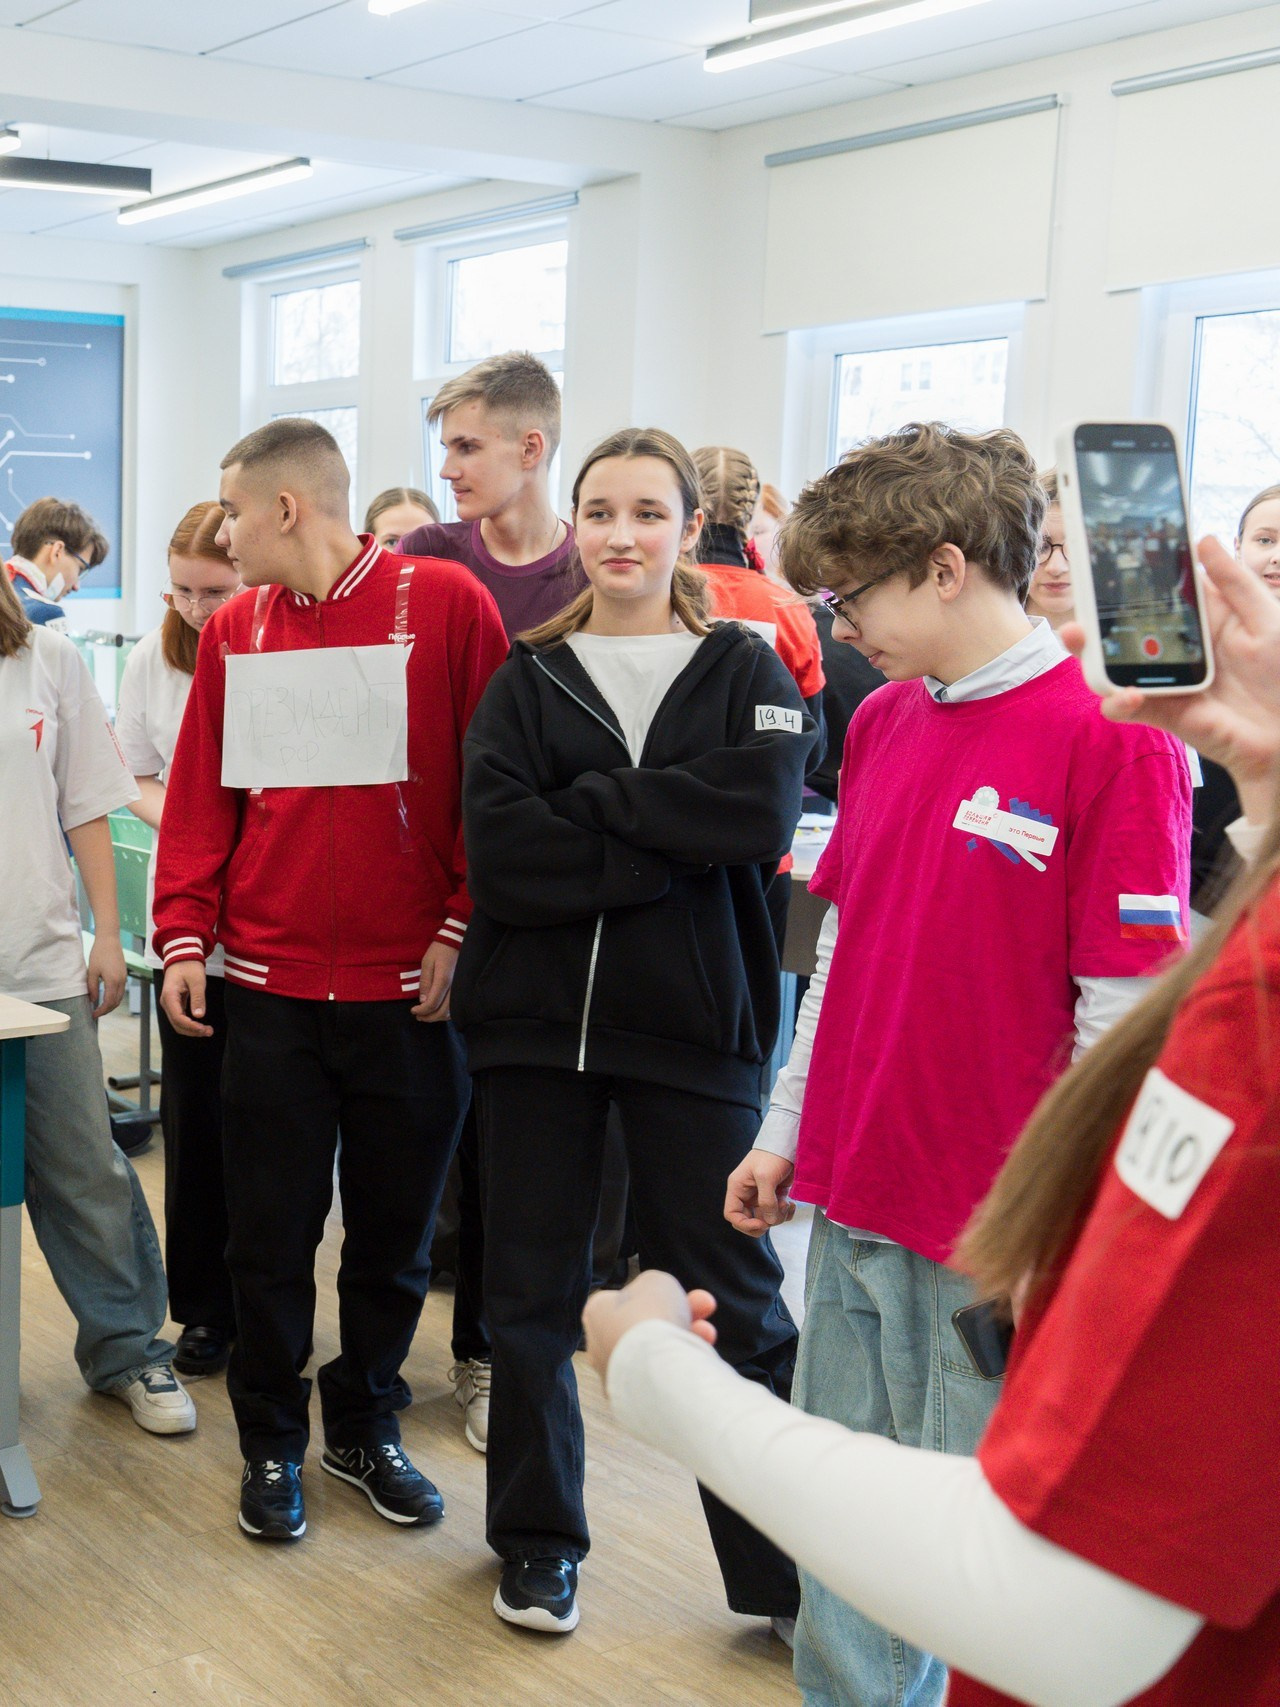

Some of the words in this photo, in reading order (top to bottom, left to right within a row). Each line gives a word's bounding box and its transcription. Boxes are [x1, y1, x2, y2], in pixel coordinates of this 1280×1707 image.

[229, 681, 405, 742] ПРЕЗИДЕНТ
[760, 708, 795, 729] 19.4
[279, 740, 320, 777] РФ
[1021, 830, 1045, 843] Первые
